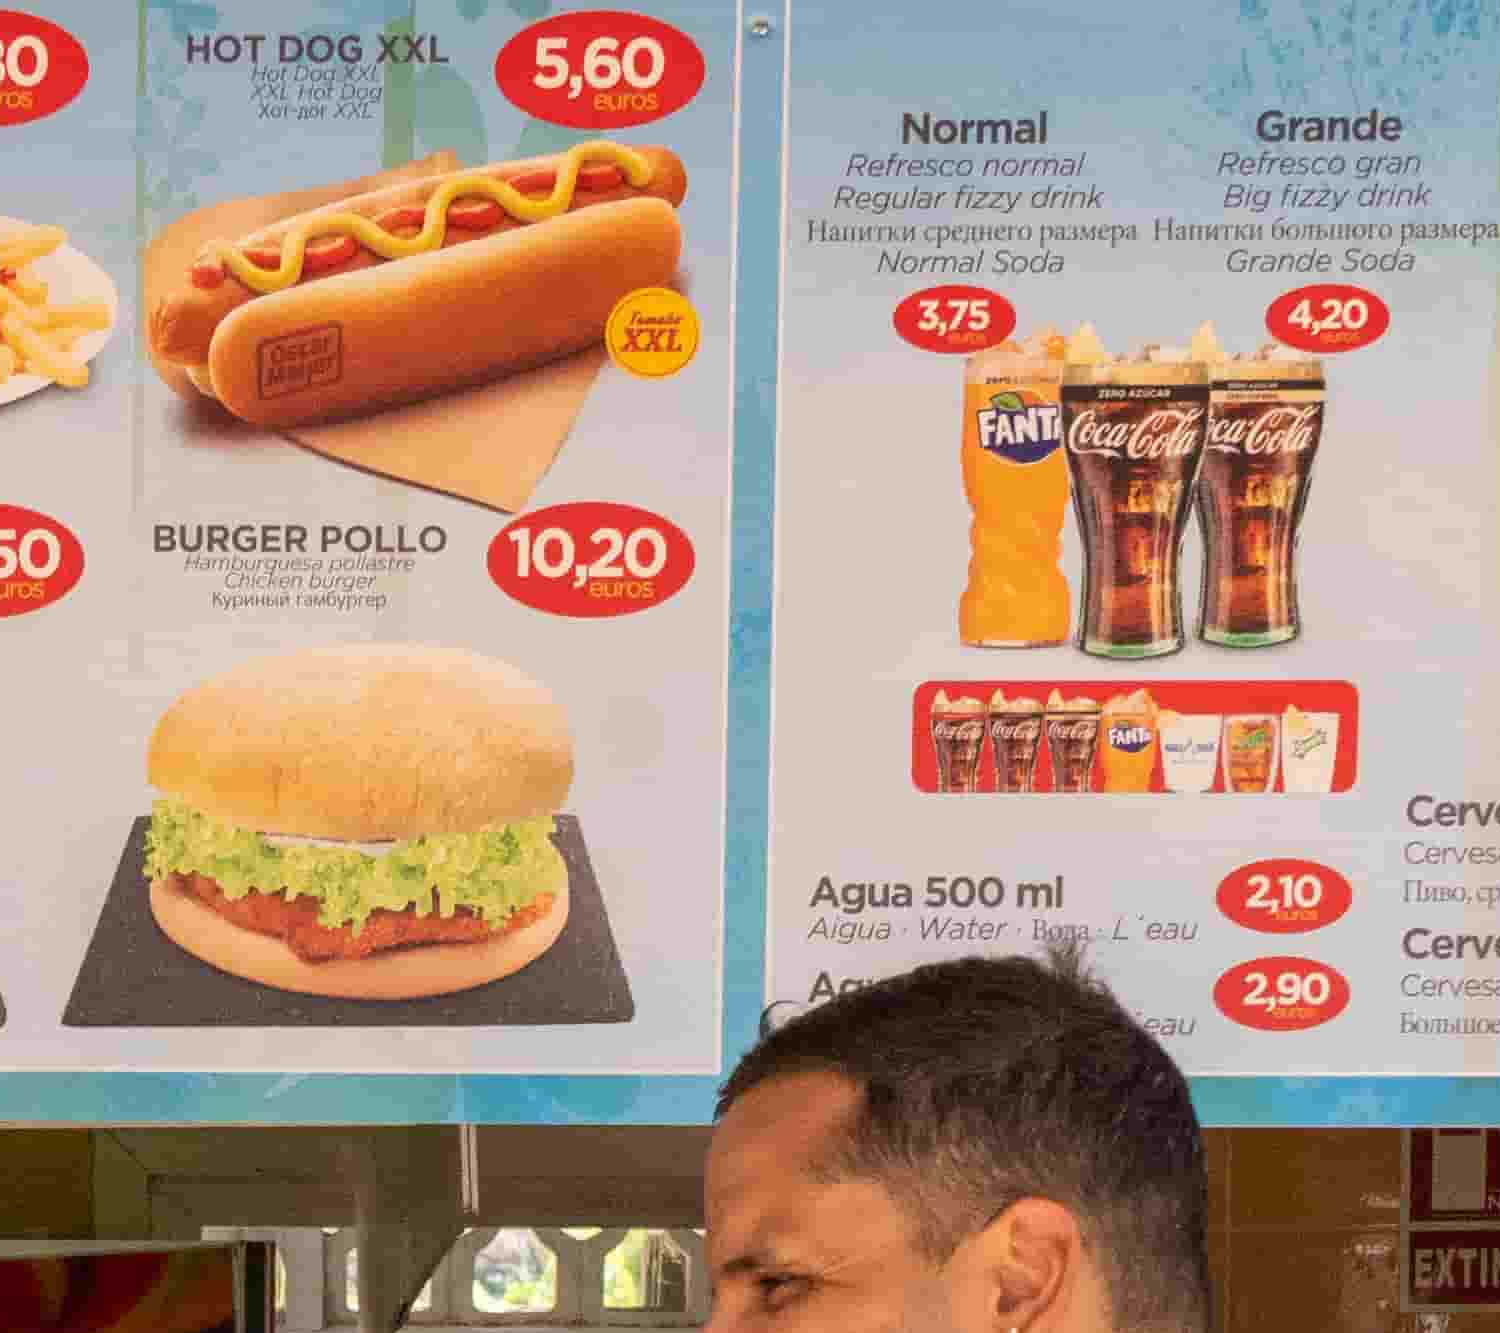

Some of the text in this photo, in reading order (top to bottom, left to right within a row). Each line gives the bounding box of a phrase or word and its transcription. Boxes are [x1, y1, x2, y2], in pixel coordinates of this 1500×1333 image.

[187, 33, 448, 64] HOT DOG XXL
[533, 37, 664, 98] 5,60
[903, 111, 1048, 144] Normal
[1256, 108, 1403, 142] Grande
[846, 152, 1086, 177] Refresco normal
[834, 184, 1104, 214] Regular fizzy drink
[808, 220, 1136, 245] Напитки среднего размера
[918, 300, 990, 335] 3,75
[1288, 299, 1368, 334] 4,20
[1069, 408, 1201, 459] Coca-Cola
[154, 525, 446, 552] BURGER POLLO
[504, 525, 666, 586] 10,20
[223, 569, 378, 593] Chicken burger
[810, 876, 1063, 914] Agua 500 ml
[1246, 875, 1322, 913] 2,10
[1244, 973, 1330, 1010] 2,90
